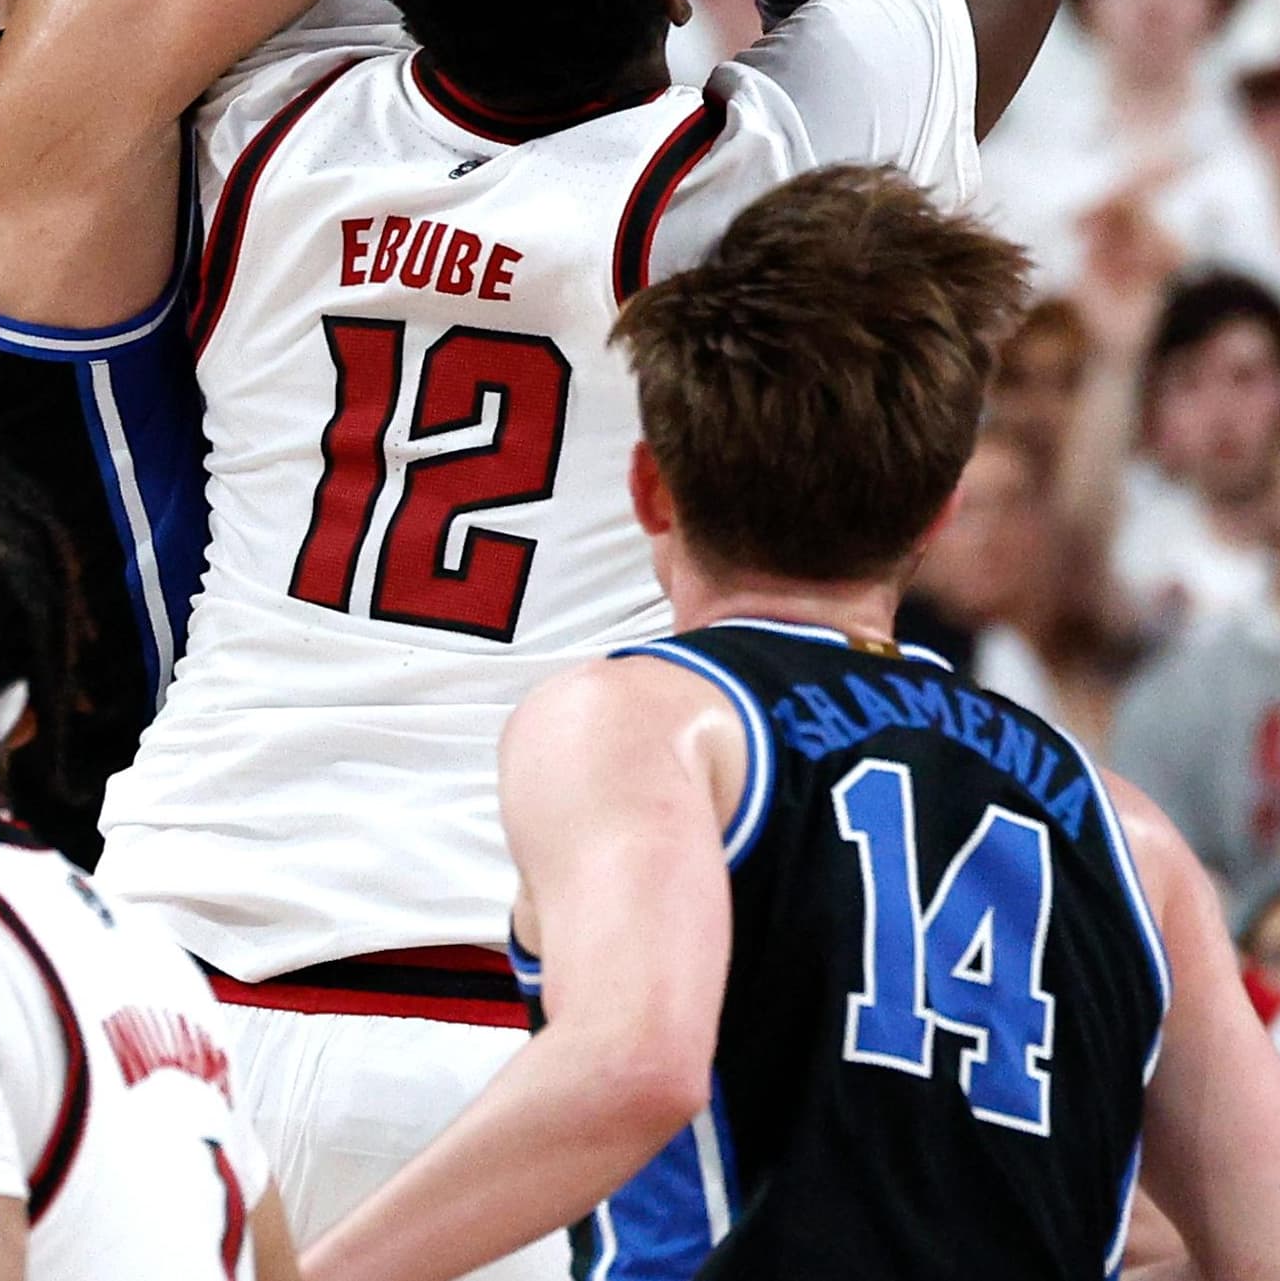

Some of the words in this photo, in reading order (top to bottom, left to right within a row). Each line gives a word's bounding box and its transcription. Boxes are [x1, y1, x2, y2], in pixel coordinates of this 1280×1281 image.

[340, 215, 524, 302] EBUBE
[288, 314, 572, 644] 12
[831, 757, 1055, 1138] 14
